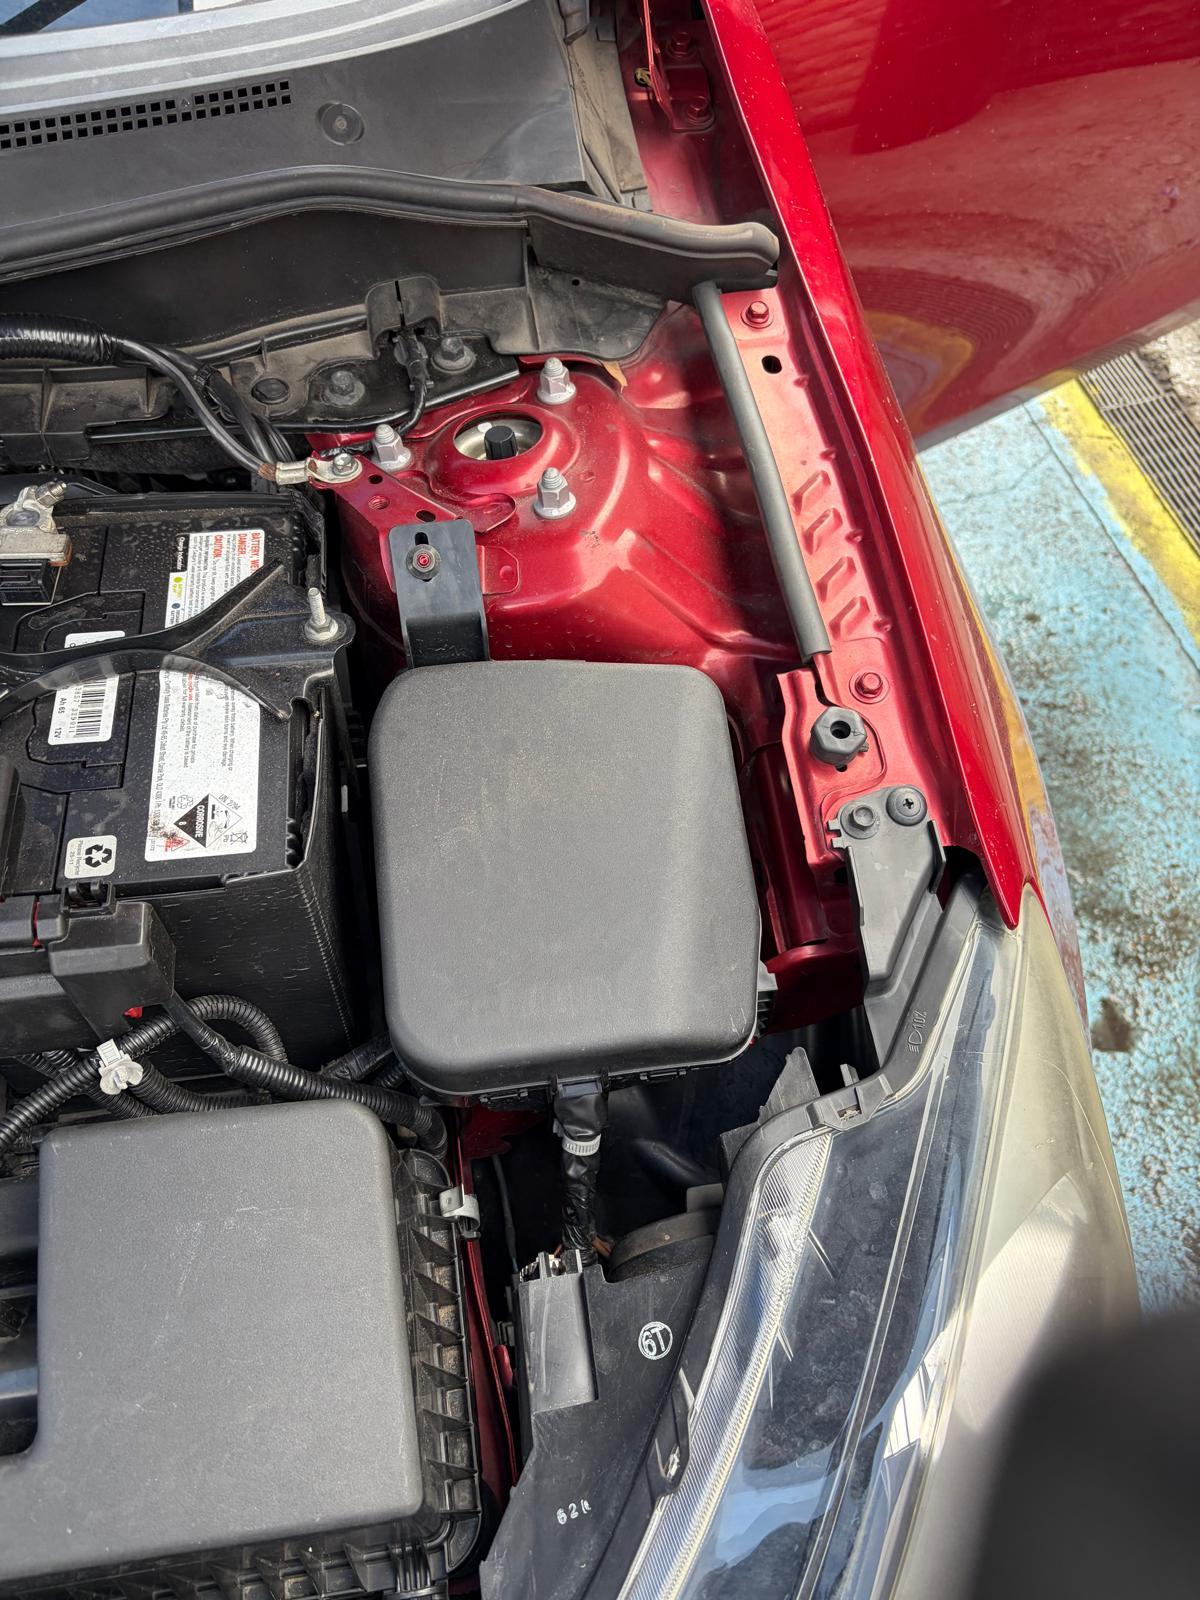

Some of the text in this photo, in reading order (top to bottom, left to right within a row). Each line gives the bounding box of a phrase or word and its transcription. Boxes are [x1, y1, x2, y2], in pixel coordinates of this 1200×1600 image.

[213, 535, 224, 560] CAUTION.
[237, 534, 248, 556] DANGER.
[60, 698, 67, 706] Ah
[54, 728, 62, 738] 12V
[195, 804, 205, 838] CORROSIVE
[641, 1325, 666, 1357] 6T
